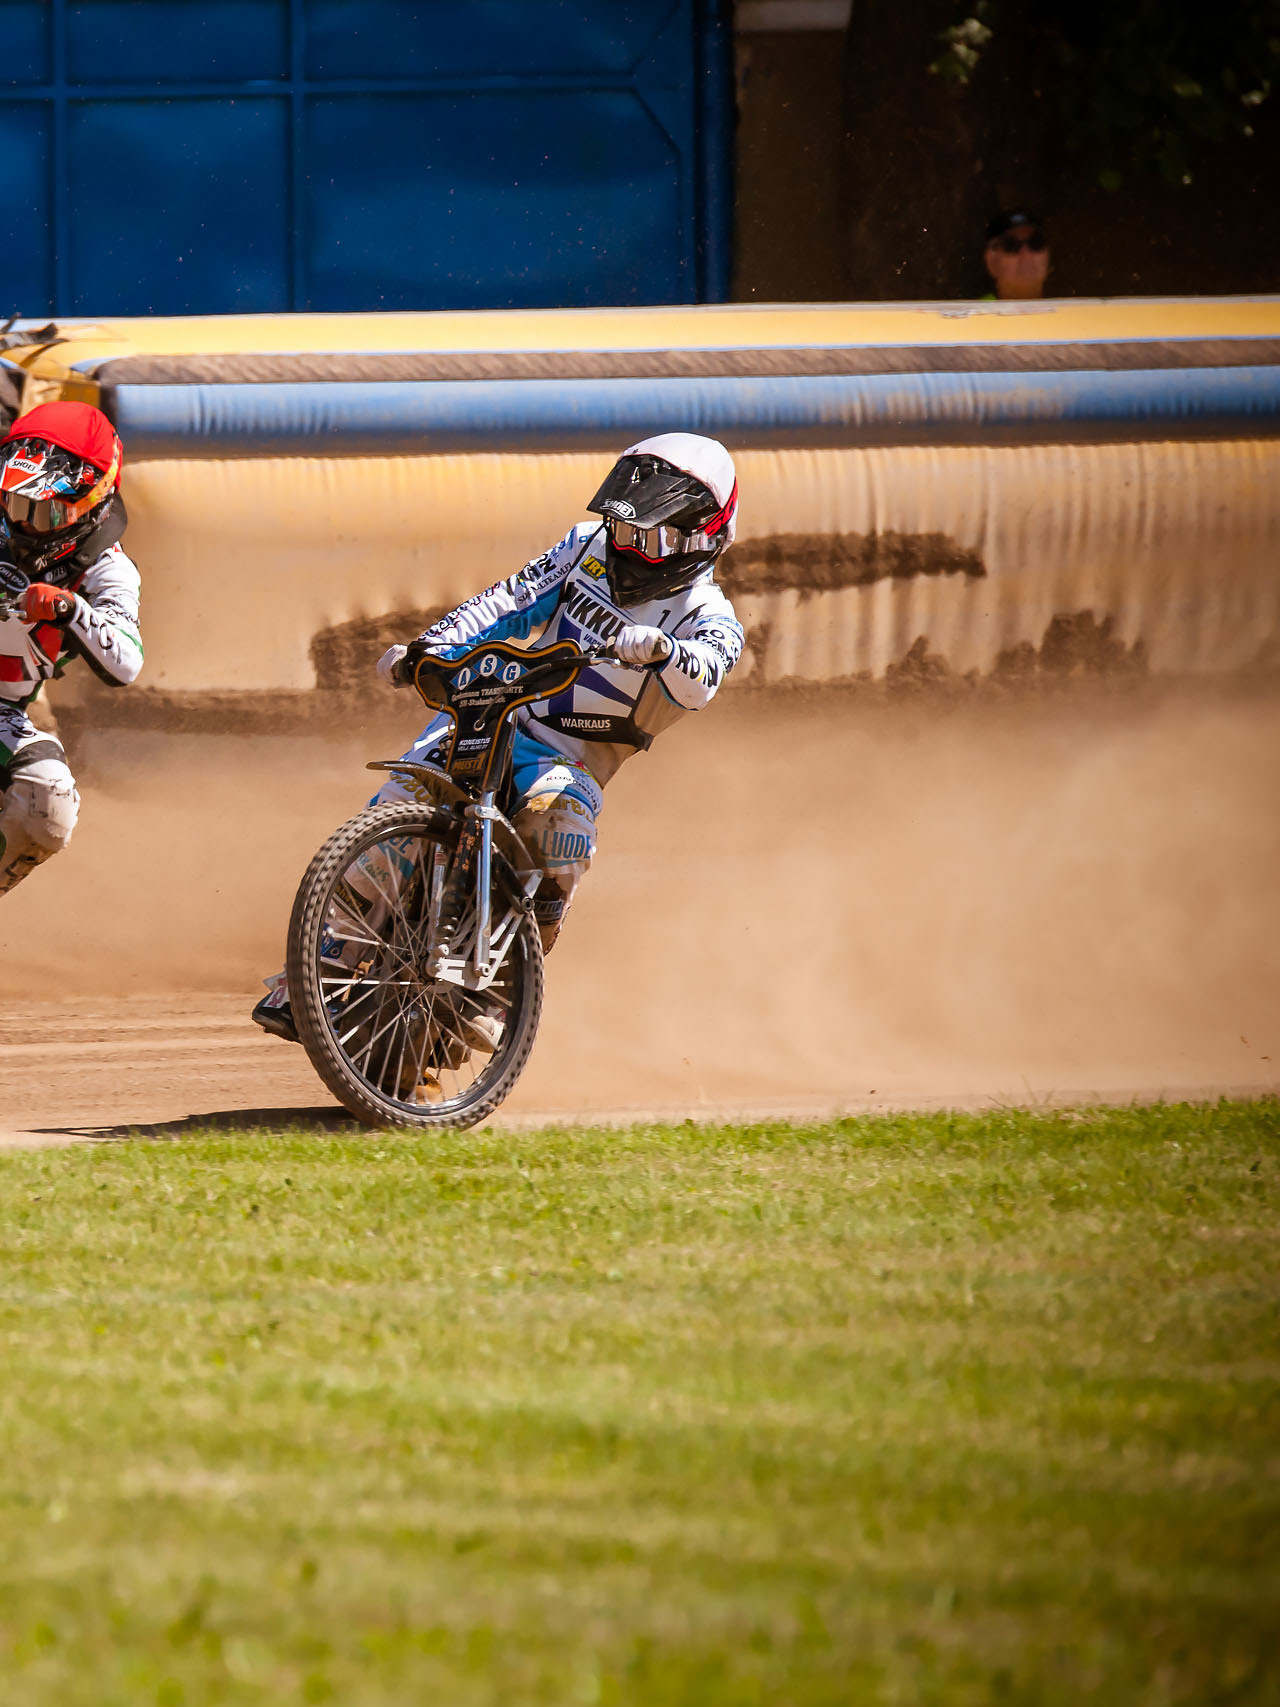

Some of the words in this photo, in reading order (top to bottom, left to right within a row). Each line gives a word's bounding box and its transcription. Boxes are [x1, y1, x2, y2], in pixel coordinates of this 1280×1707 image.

[11, 460, 37, 473] SHOEI
[604, 499, 634, 517] SHOEI
[582, 554, 607, 578] VRT
[561, 717, 611, 729] WARKAUS
